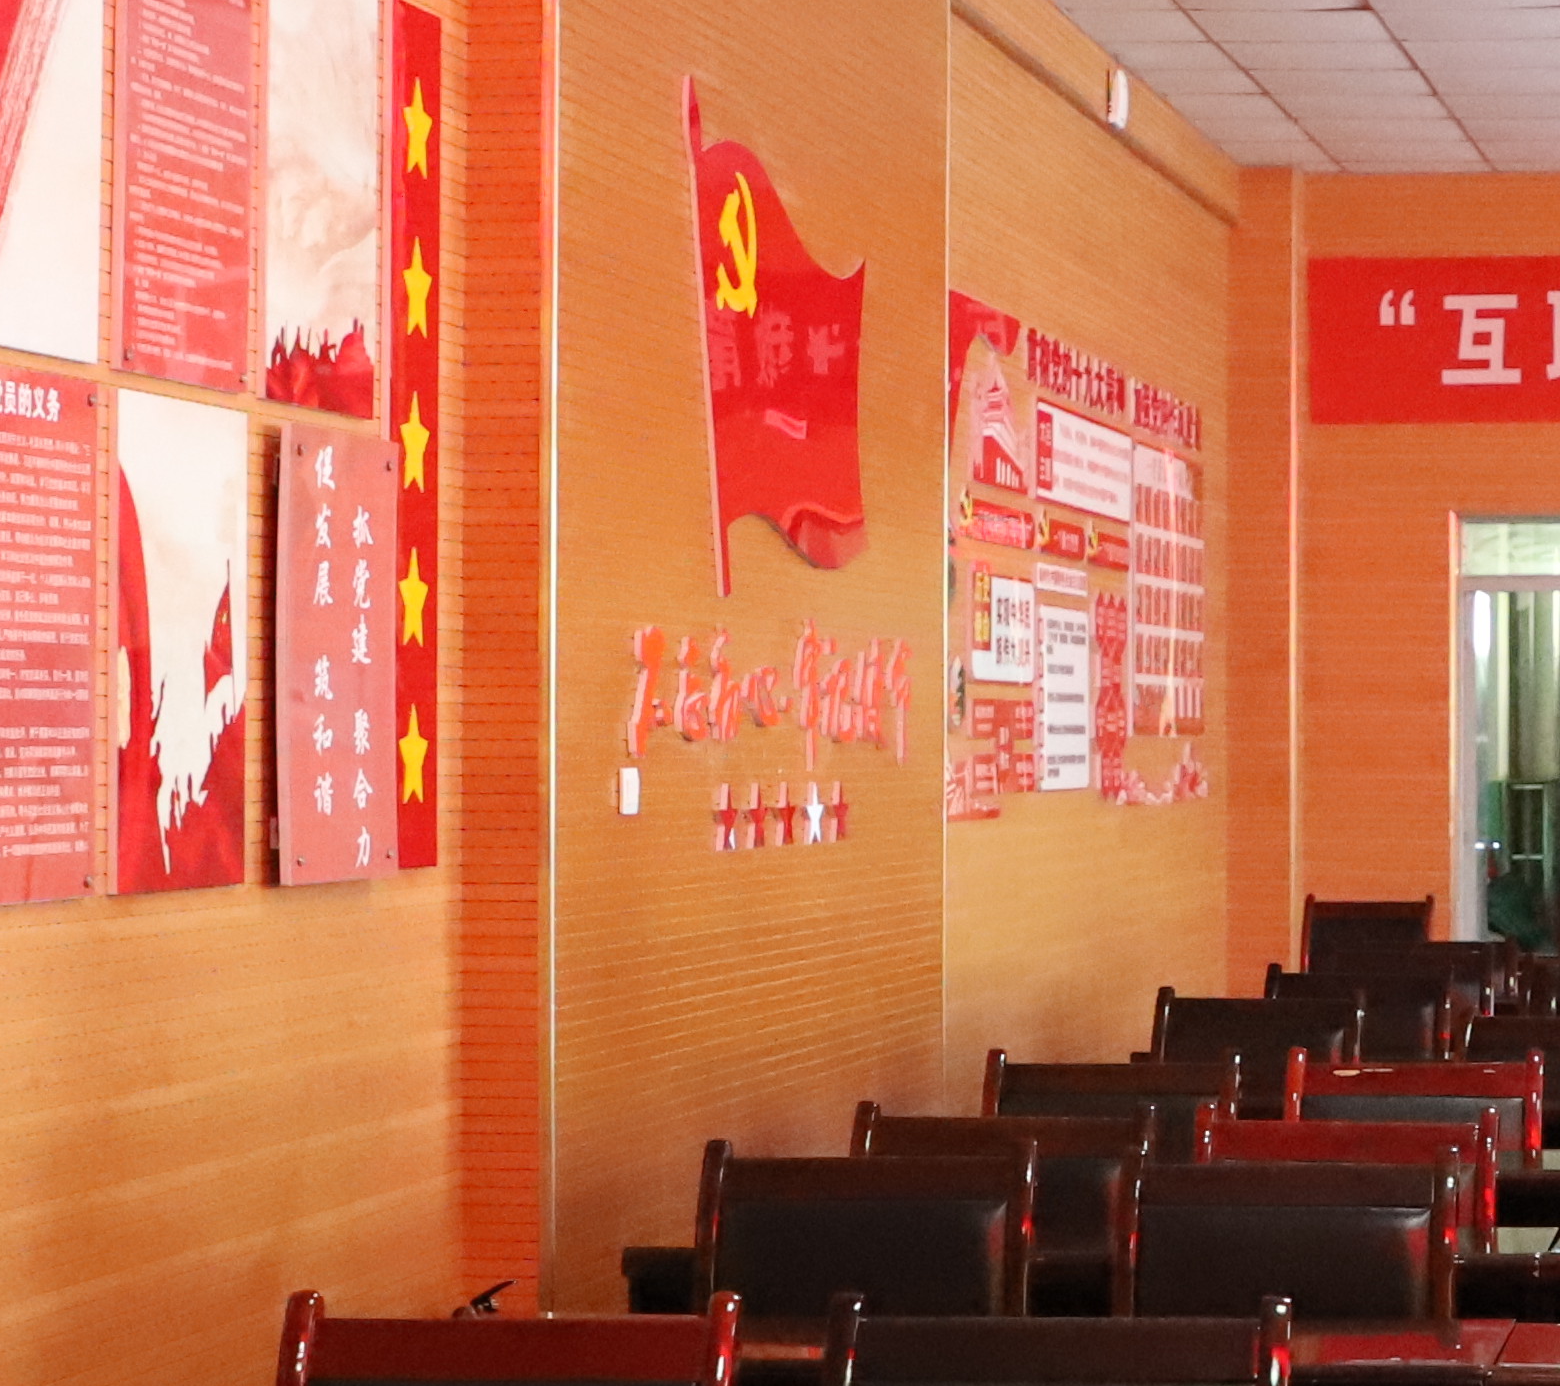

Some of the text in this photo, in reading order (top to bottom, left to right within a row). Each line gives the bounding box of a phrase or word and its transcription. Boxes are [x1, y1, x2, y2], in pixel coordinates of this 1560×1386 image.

[312, 444, 336, 817] 促发展 筑和谐
[351, 505, 374, 868] 抓党建 聚合力
